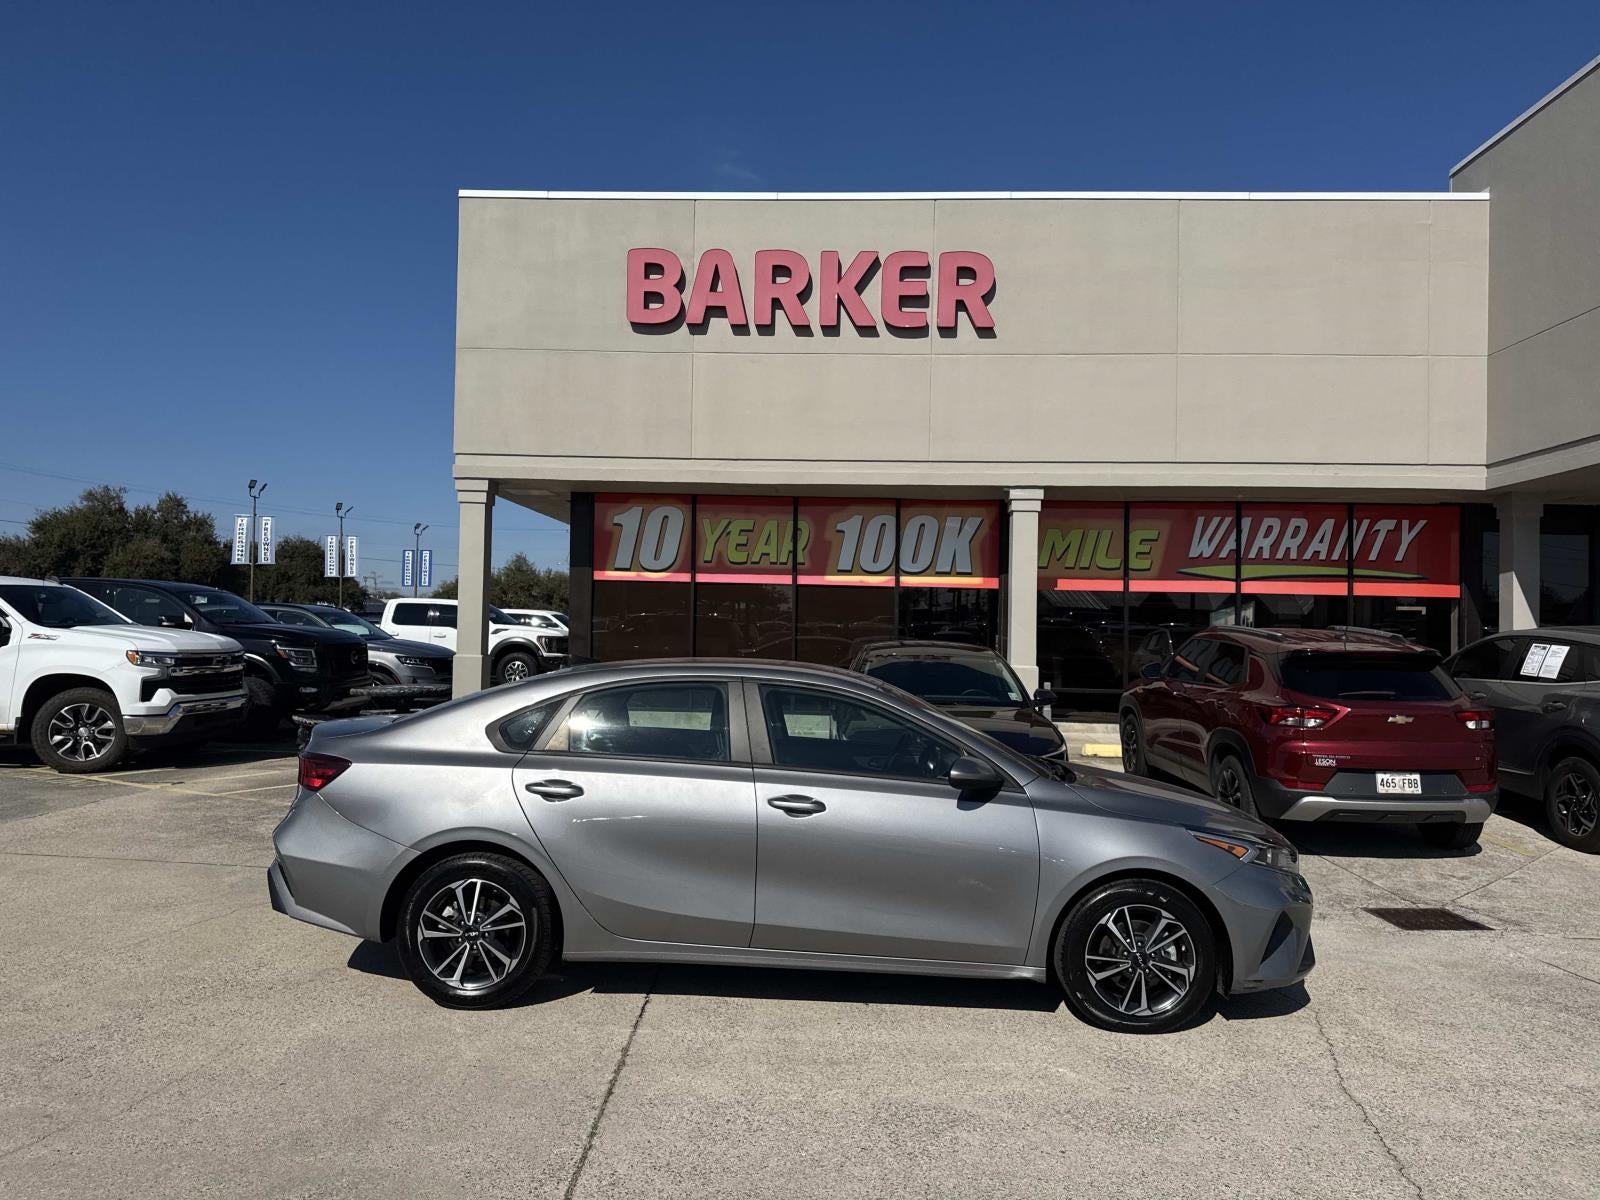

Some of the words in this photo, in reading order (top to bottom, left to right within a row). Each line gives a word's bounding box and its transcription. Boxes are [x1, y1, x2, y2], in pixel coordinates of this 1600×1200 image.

[627, 247, 995, 330] BARKER
[612, 505, 685, 571] 10
[702, 517, 810, 566] YEAR
[835, 514, 984, 574] 100K
[1038, 528, 1160, 571] MILE
[1188, 515, 1428, 563] WARRANTY
[1379, 777, 1397, 789] 465
[1402, 778, 1419, 789] FBB
